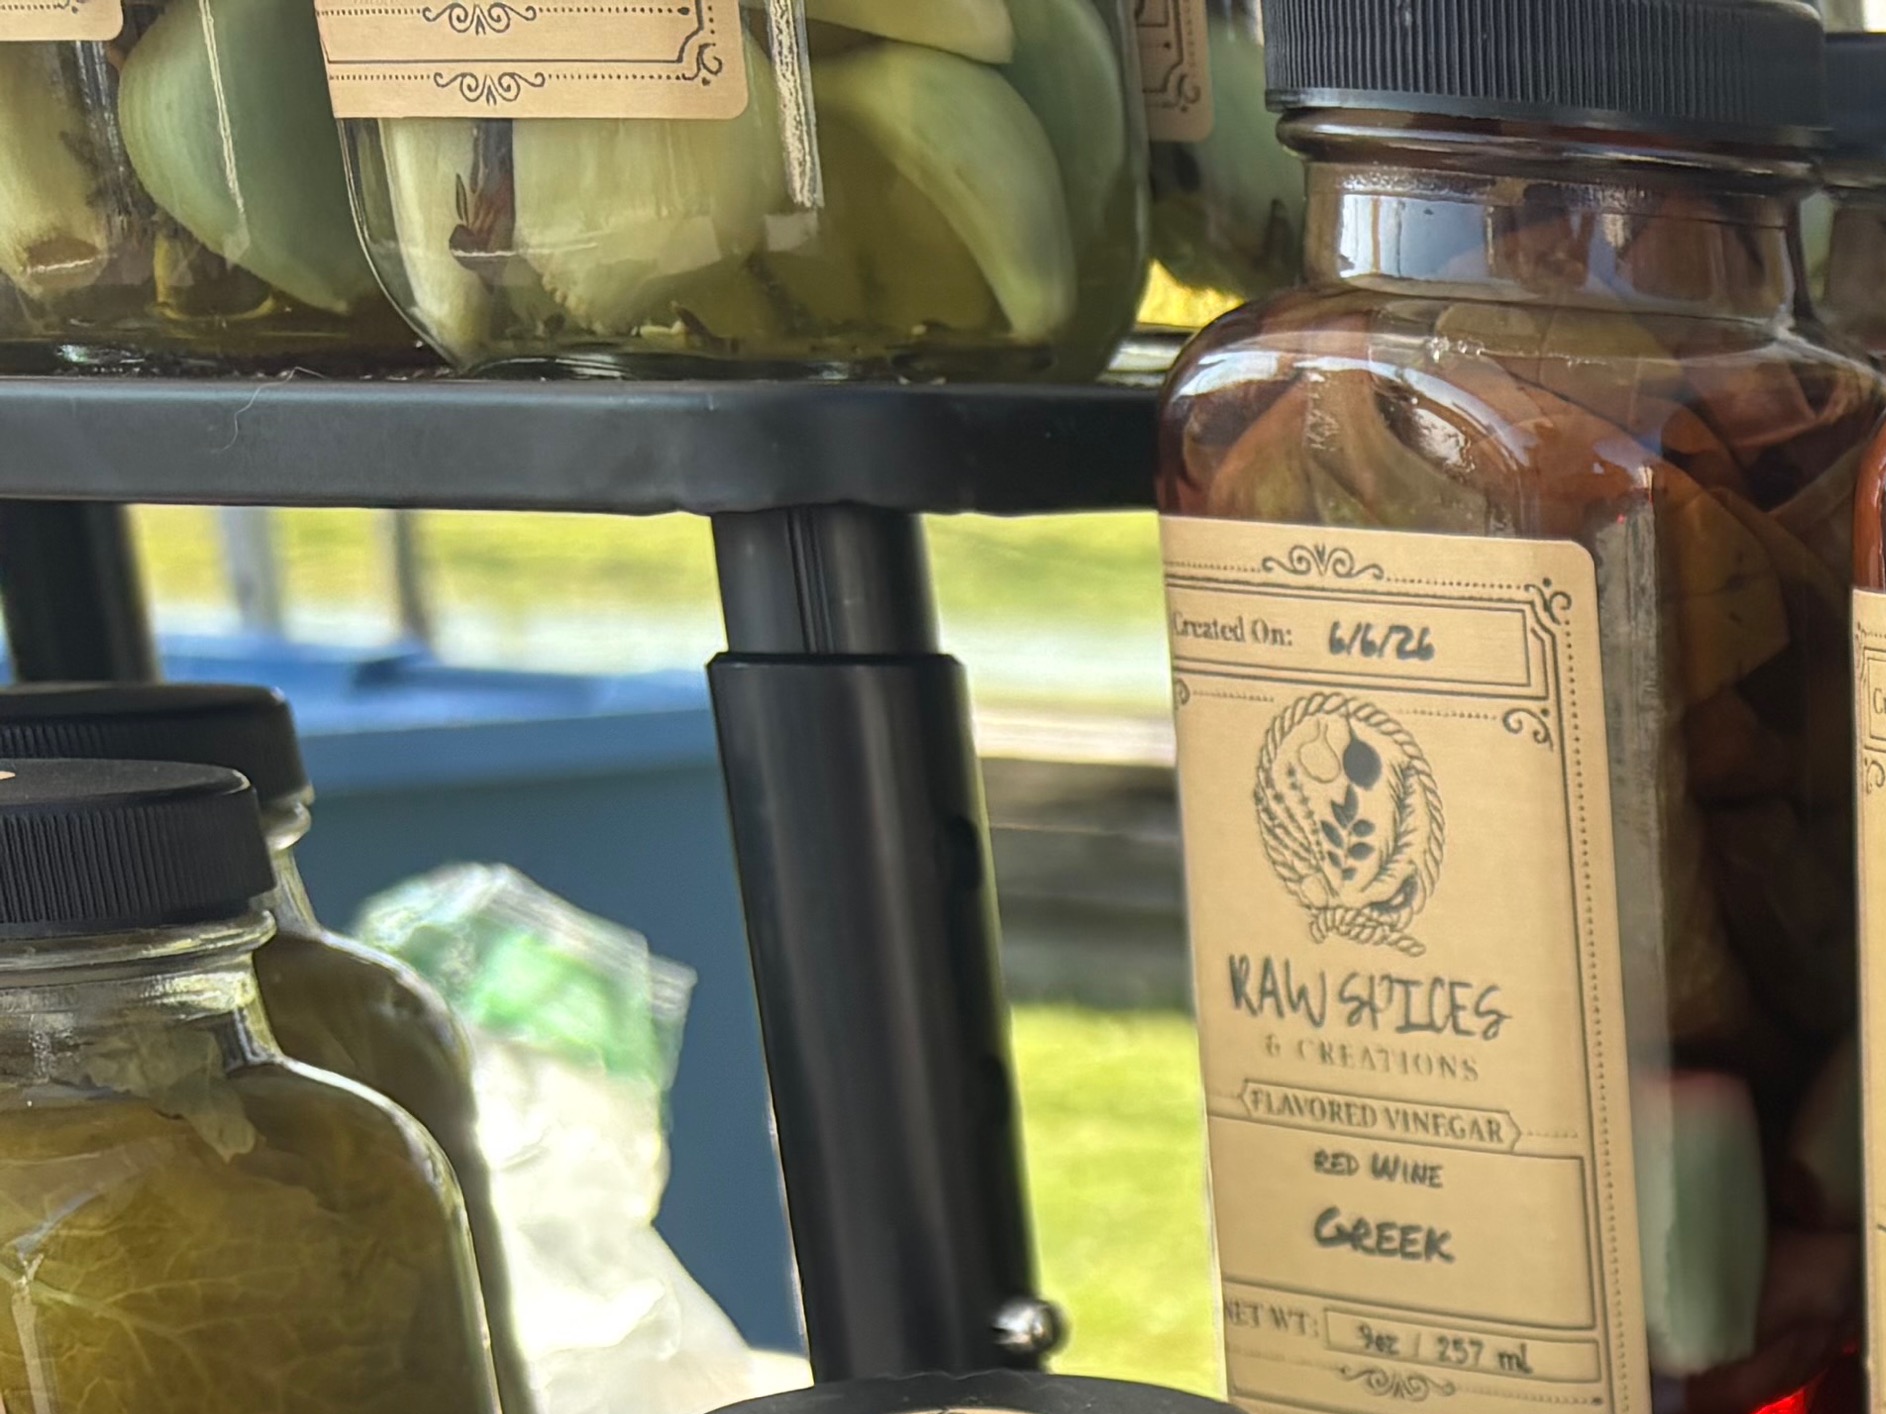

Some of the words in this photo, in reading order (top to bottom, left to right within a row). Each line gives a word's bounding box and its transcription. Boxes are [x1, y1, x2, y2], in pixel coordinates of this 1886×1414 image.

[1173, 611, 1245, 642] Created
[1251, 618, 1292, 646] On:
[1329, 621, 1435, 661] 6/6/26
[1229, 953, 1327, 1029] RAW
[1339, 971, 1512, 1041] SPICES
[1300, 1039, 1479, 1082] CREATIONS
[1251, 1087, 1377, 1129] FLAVORED
[1384, 1108, 1504, 1144] VINEGAR
[1314, 1149, 1359, 1176] RED
[1371, 1152, 1444, 1188] WINE
[1313, 1206, 1455, 1263] GREEK
[1437, 1335, 1484, 1367] 257
